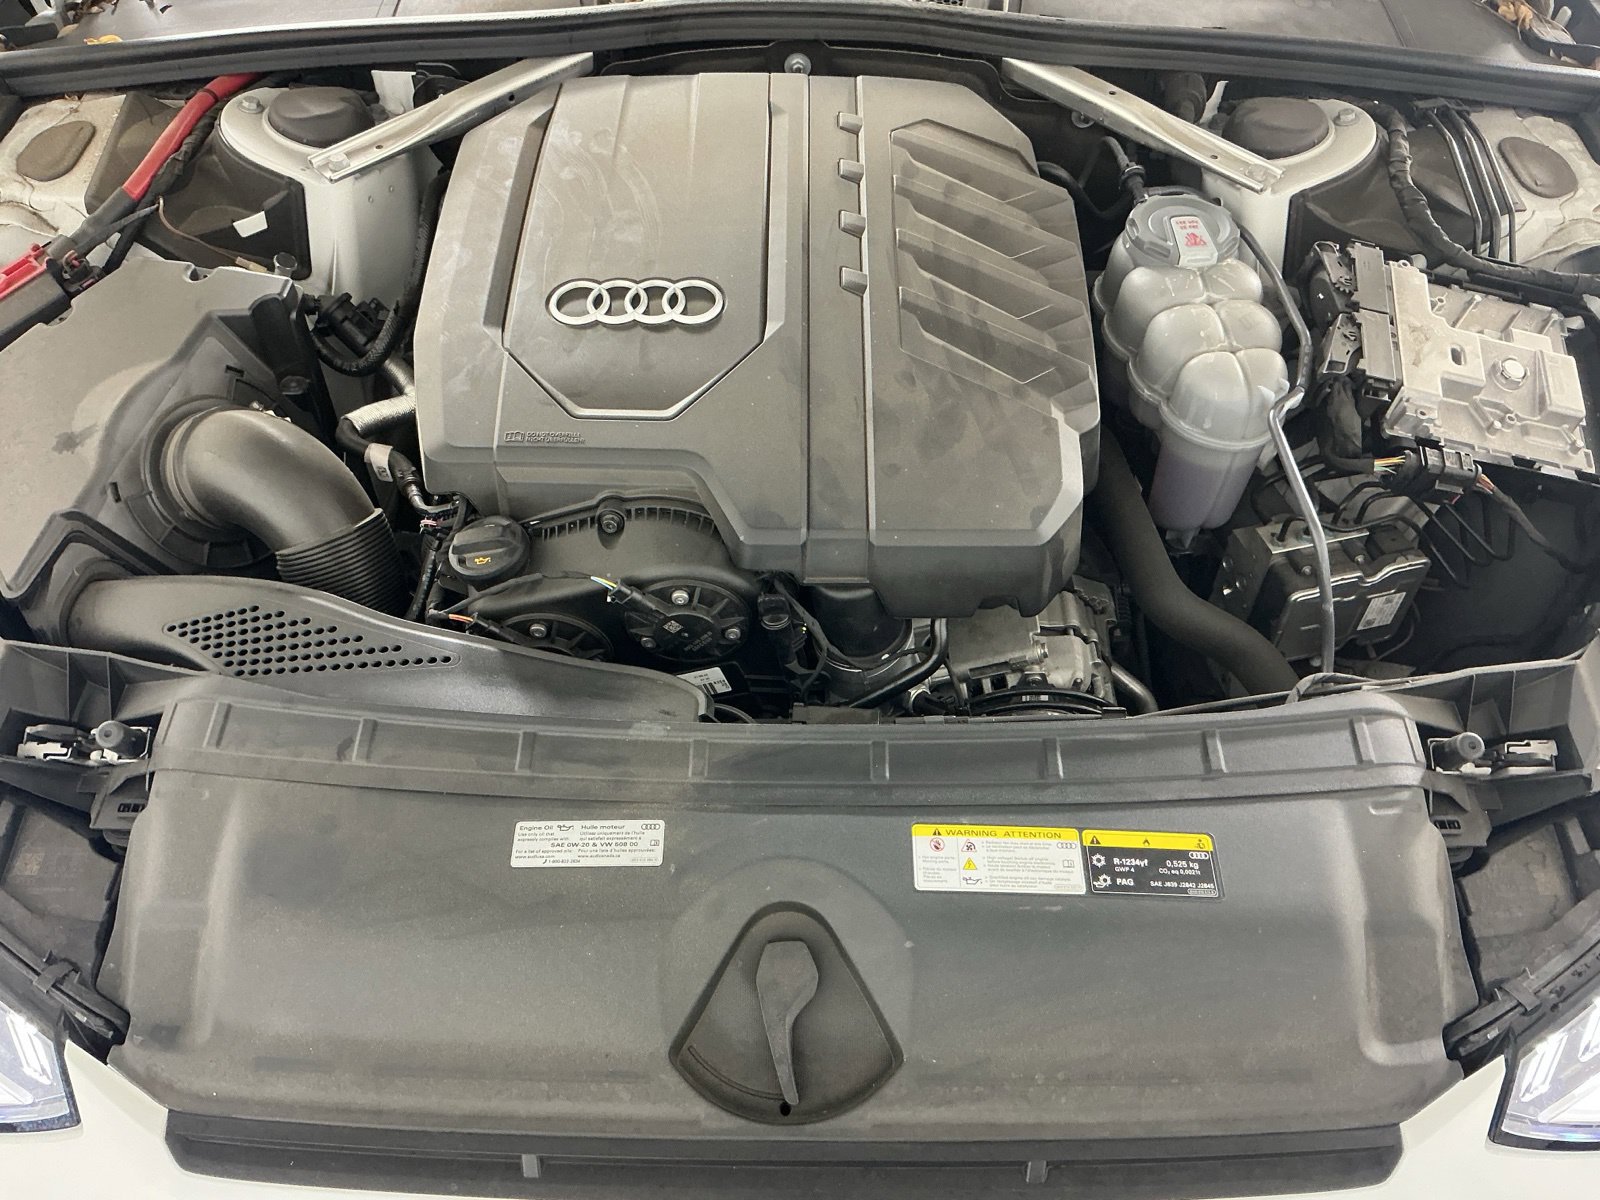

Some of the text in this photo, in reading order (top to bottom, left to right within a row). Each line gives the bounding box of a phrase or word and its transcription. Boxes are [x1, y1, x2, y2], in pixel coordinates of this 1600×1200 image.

[1004, 830, 1062, 838] ATTENTION
[1113, 858, 1148, 867] R-1234yf
[1189, 861, 1199, 869] kg
